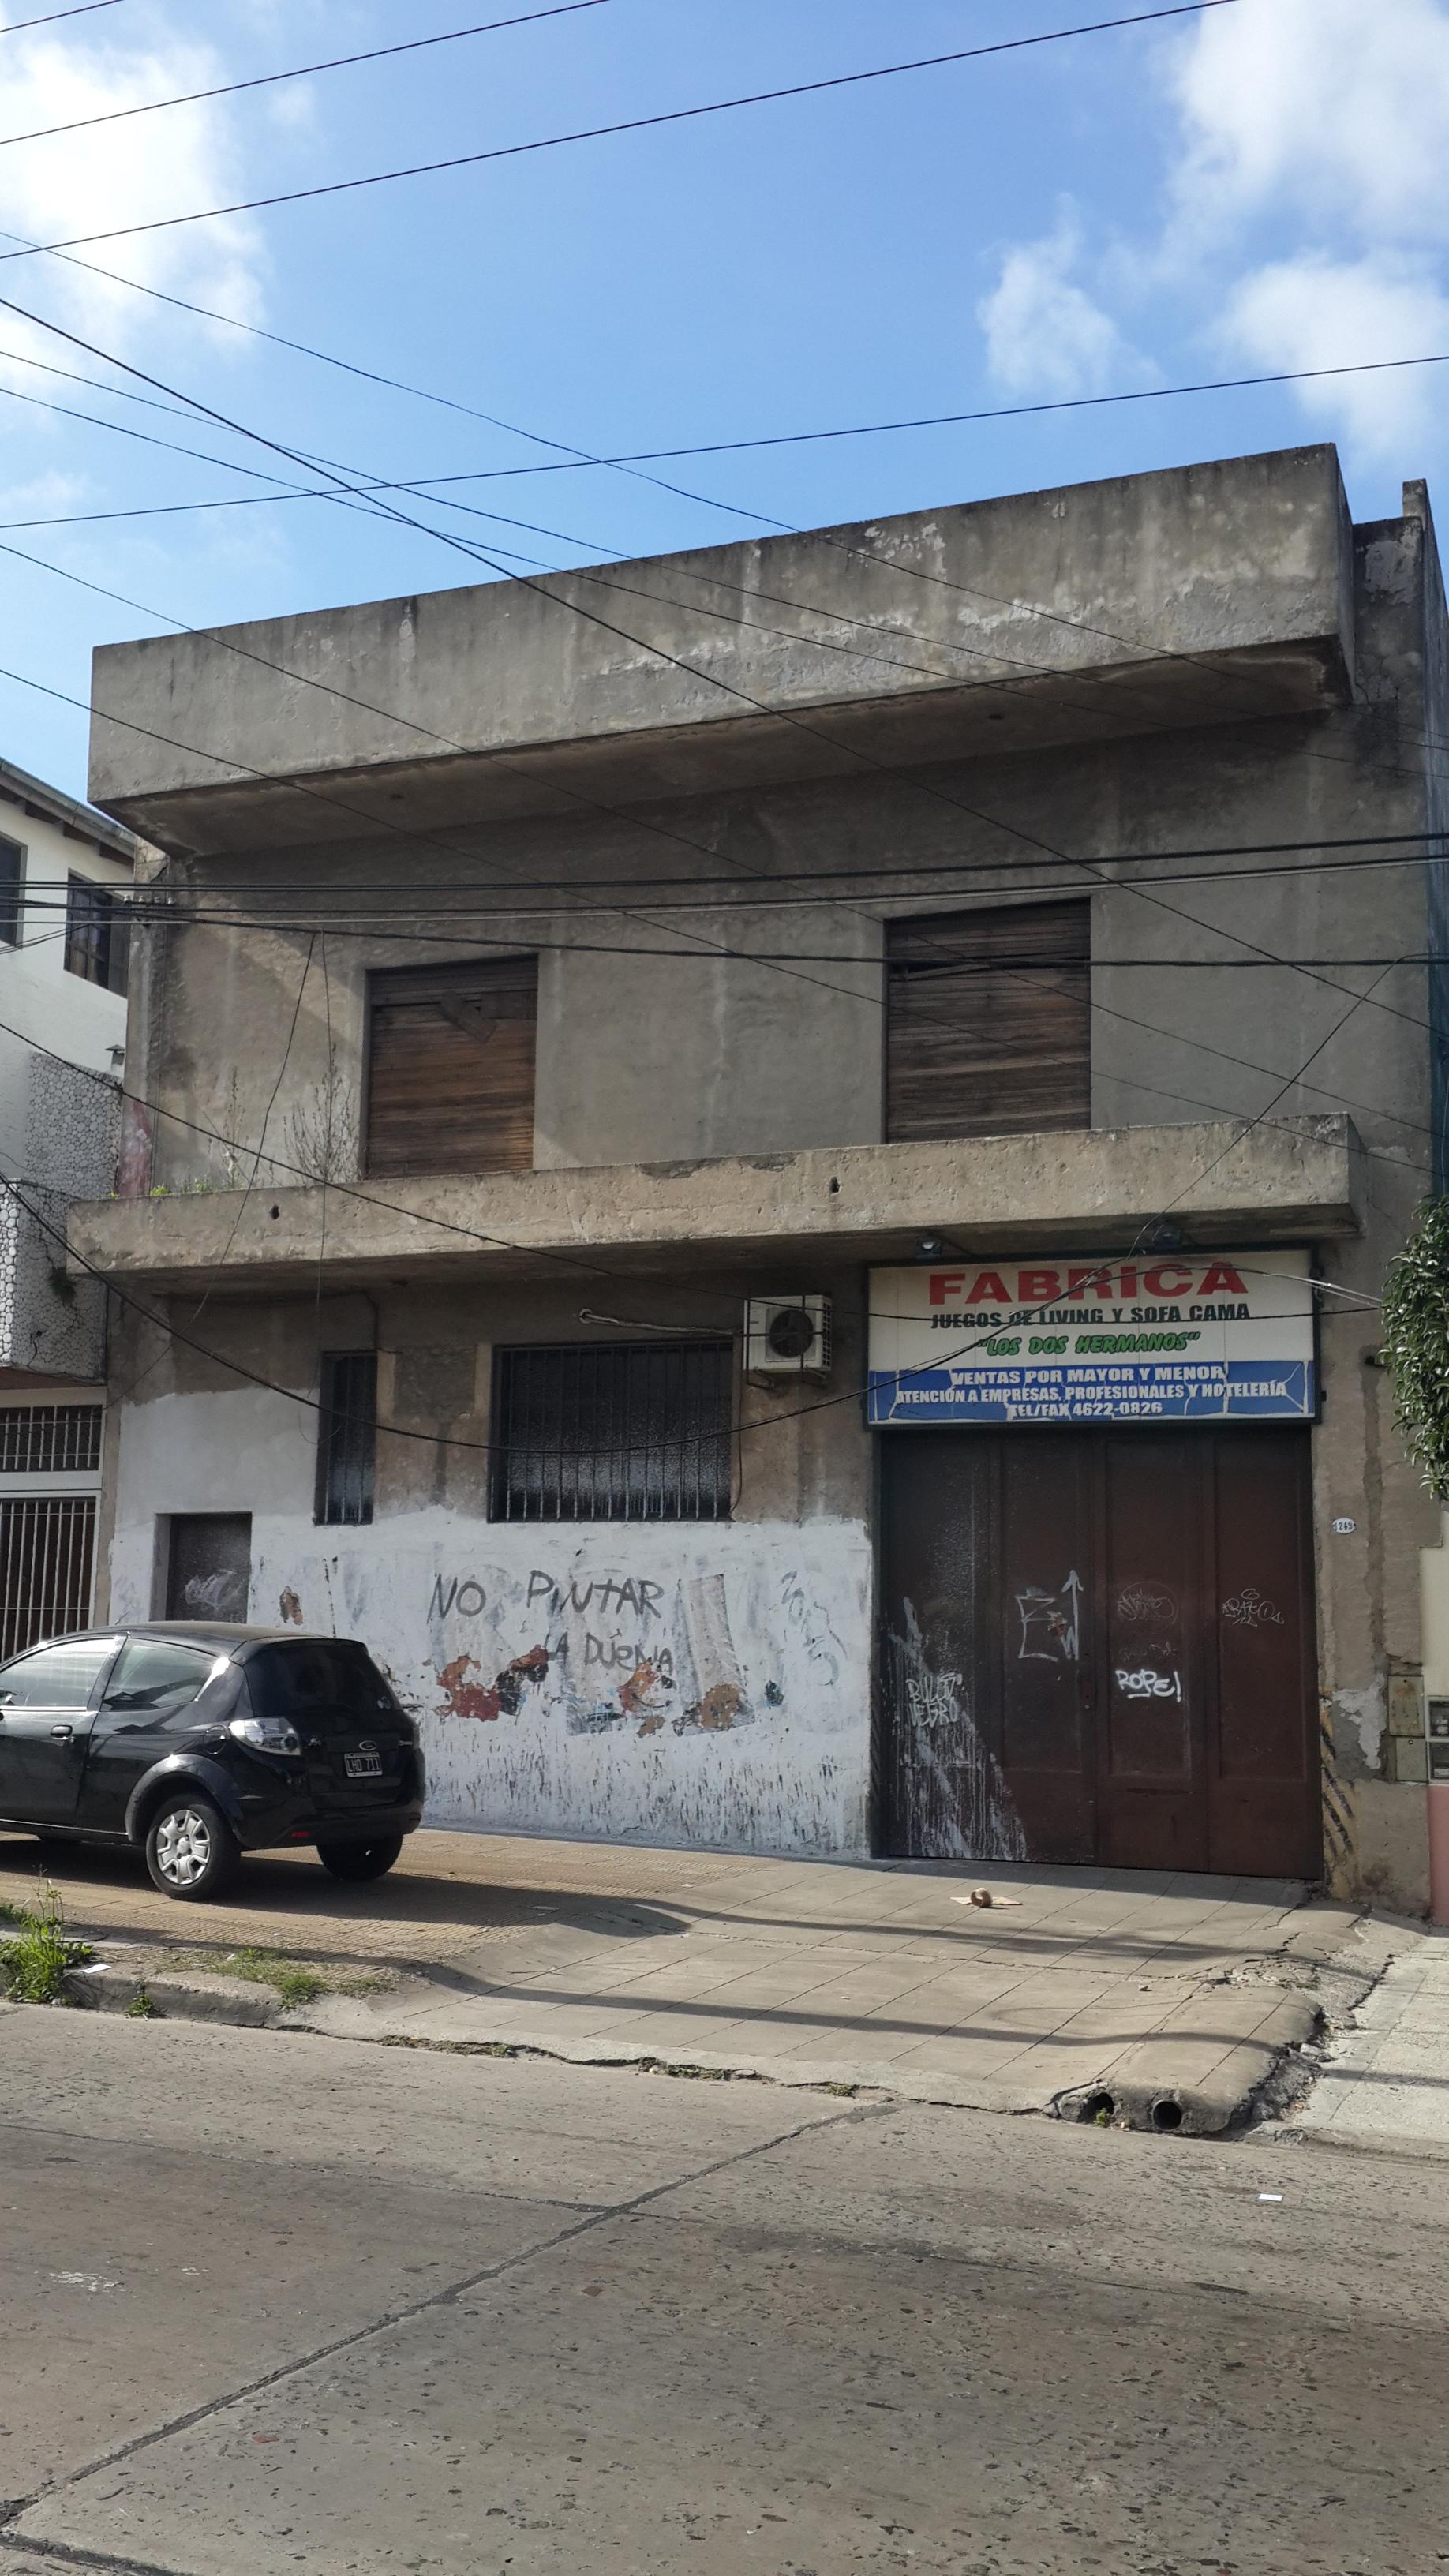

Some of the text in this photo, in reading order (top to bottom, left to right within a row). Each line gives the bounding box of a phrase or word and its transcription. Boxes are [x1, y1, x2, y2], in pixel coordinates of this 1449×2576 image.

[930, 1262, 1249, 1305] FABRICA
[930, 1303, 1250, 1329] JUEGOS DE LIVING Y SOFA CAMA
[1028, 1335, 1069, 1354] DOS
[951, 1365, 1225, 1386] VENTAS POR MAYOR Y MENOR
[968, 1389, 979, 1402] A
[981, 1387, 1061, 1402] EMPRESAS,
[1065, 1384, 1184, 1400] PROFESIONALES
[1188, 1383, 1199, 1398] Y
[1008, 1402, 1163, 1417] TEL/FAX 4622-0826
[427, 1570, 665, 1624] NO PINTAR
